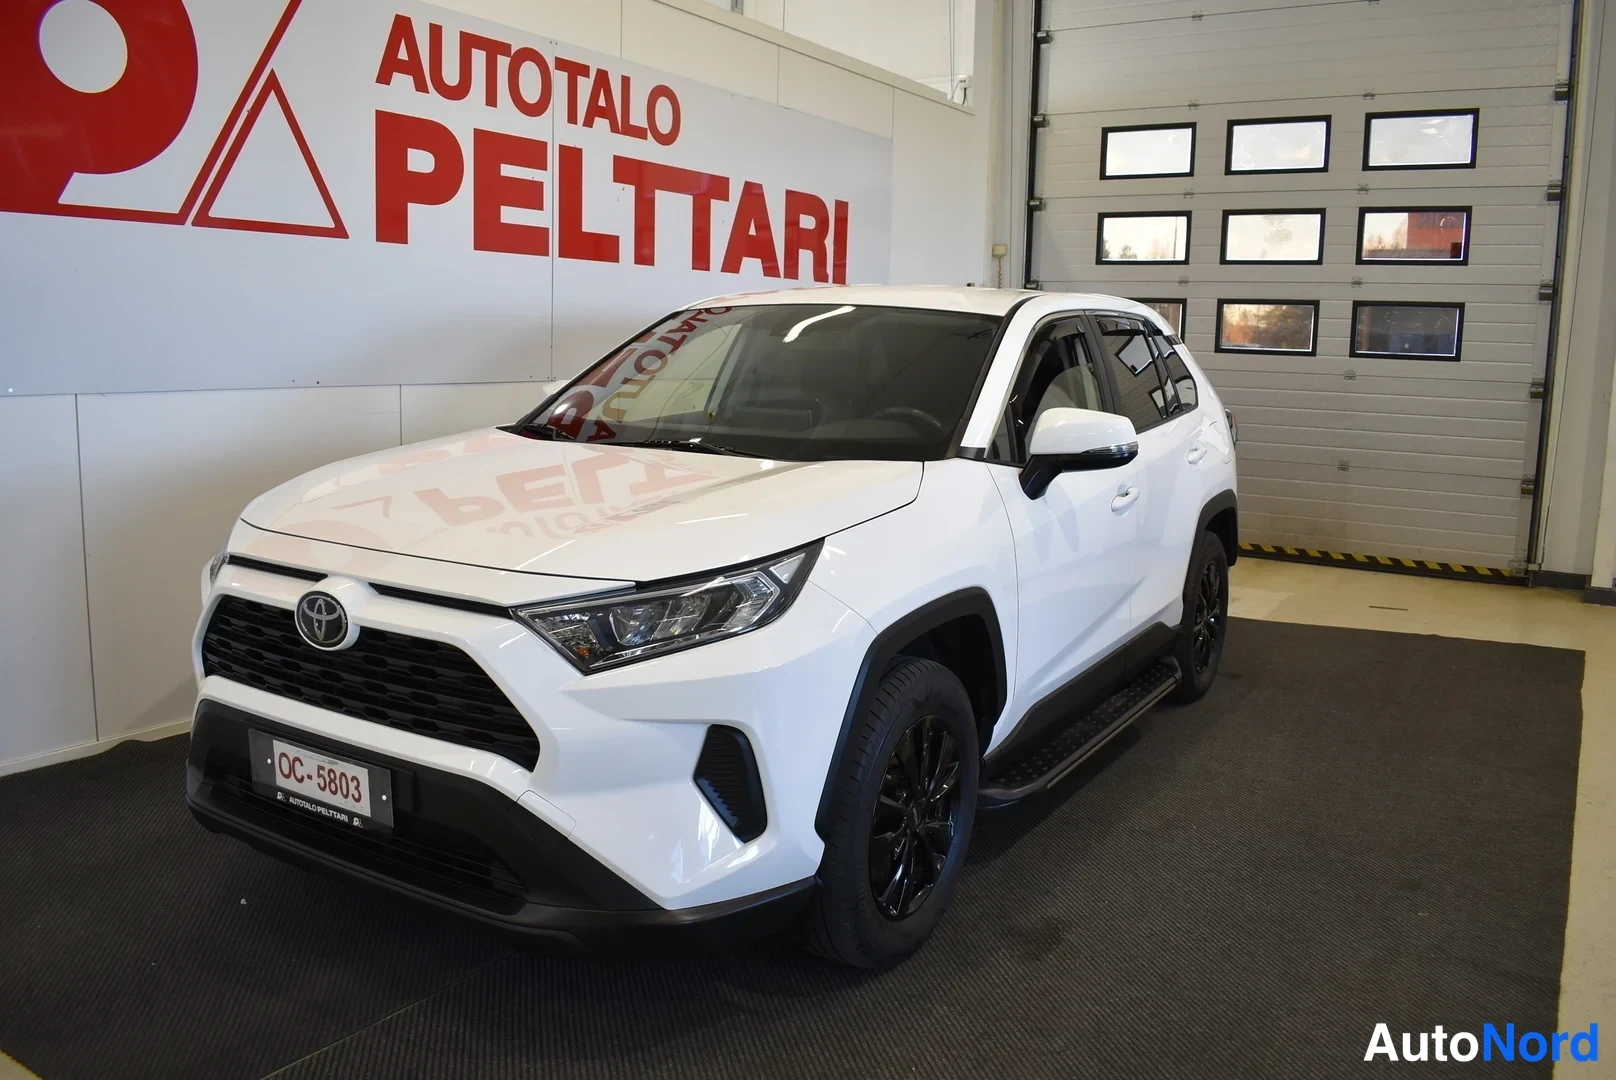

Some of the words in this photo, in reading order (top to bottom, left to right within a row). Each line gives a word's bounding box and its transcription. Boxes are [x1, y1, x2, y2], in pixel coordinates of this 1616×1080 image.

[375, 14, 681, 147] AUTOTALO
[375, 109, 850, 285] PELTTARI
[278, 751, 363, 804] OC-5803
[288, 795, 317, 812] AUTOTALO
[317, 805, 349, 823] PELTTARI
